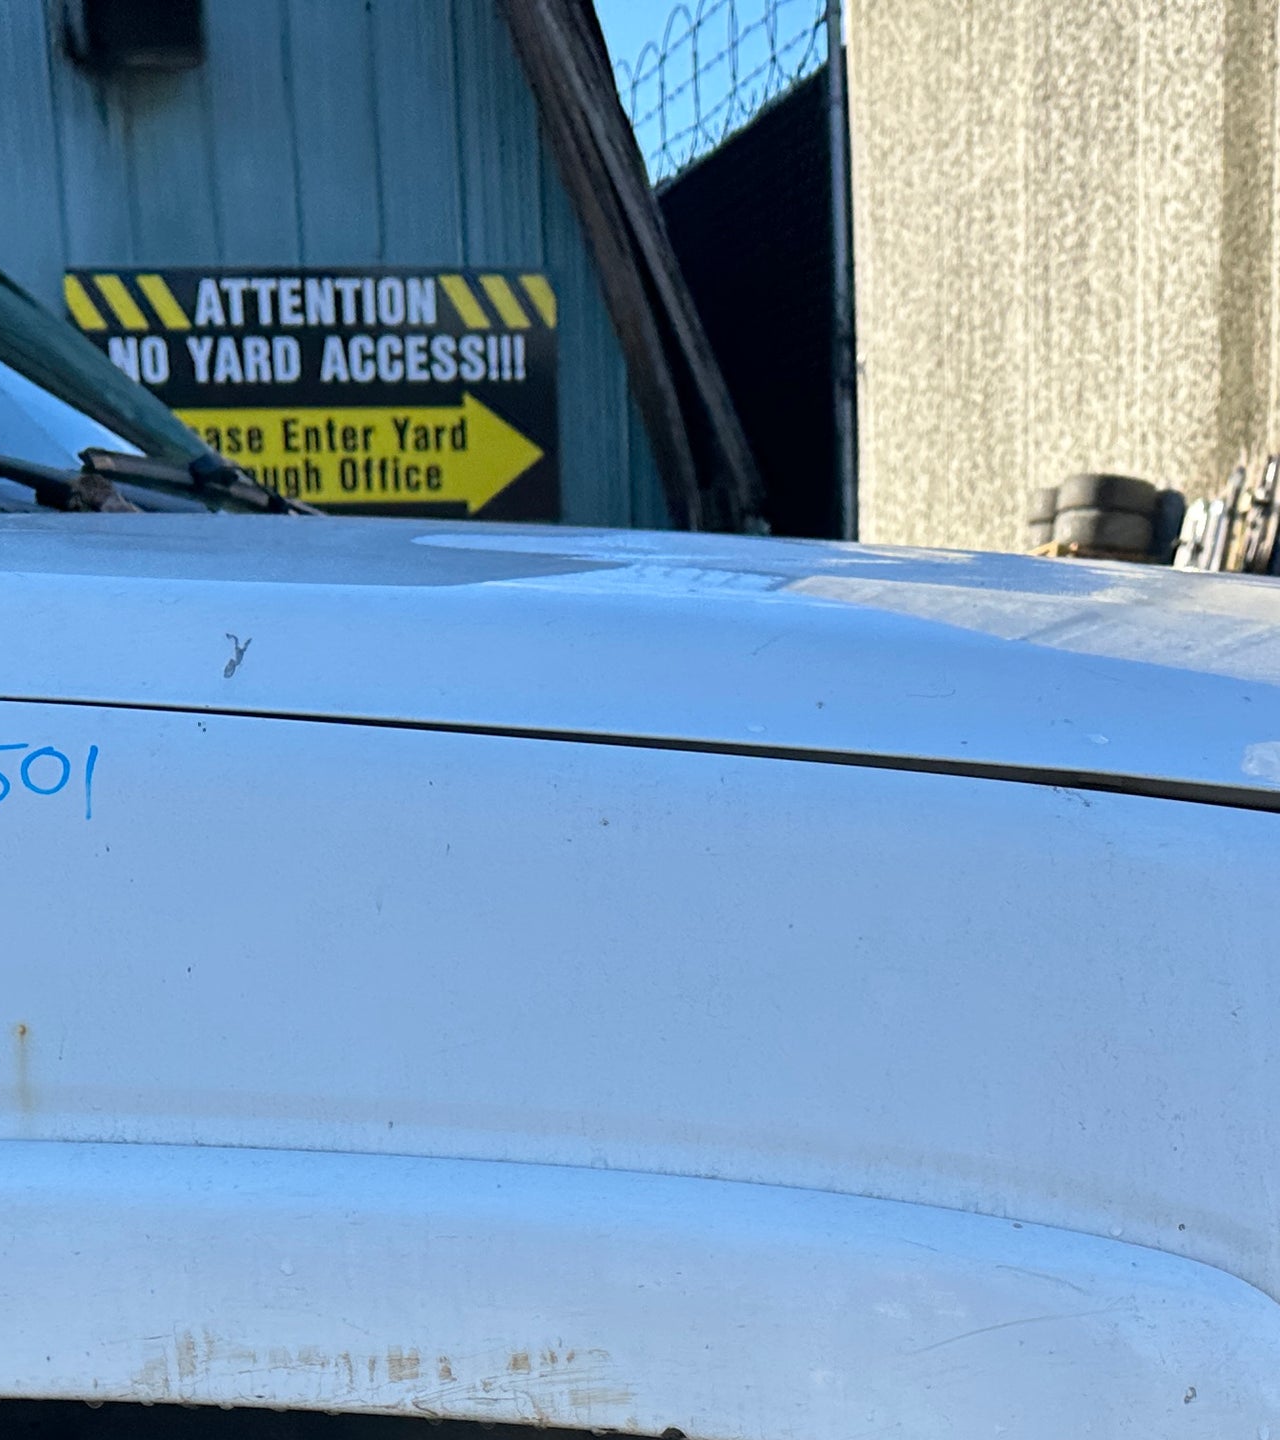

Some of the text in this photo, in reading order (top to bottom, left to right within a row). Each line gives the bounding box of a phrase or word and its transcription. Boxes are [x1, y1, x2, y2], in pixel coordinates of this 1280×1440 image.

[194, 277, 437, 327] ATTENTION
[108, 335, 526, 385] NO YARD ACCESS!!!
[194, 417, 467, 453] ase Enter Yard
[340, 458, 444, 492] Office
